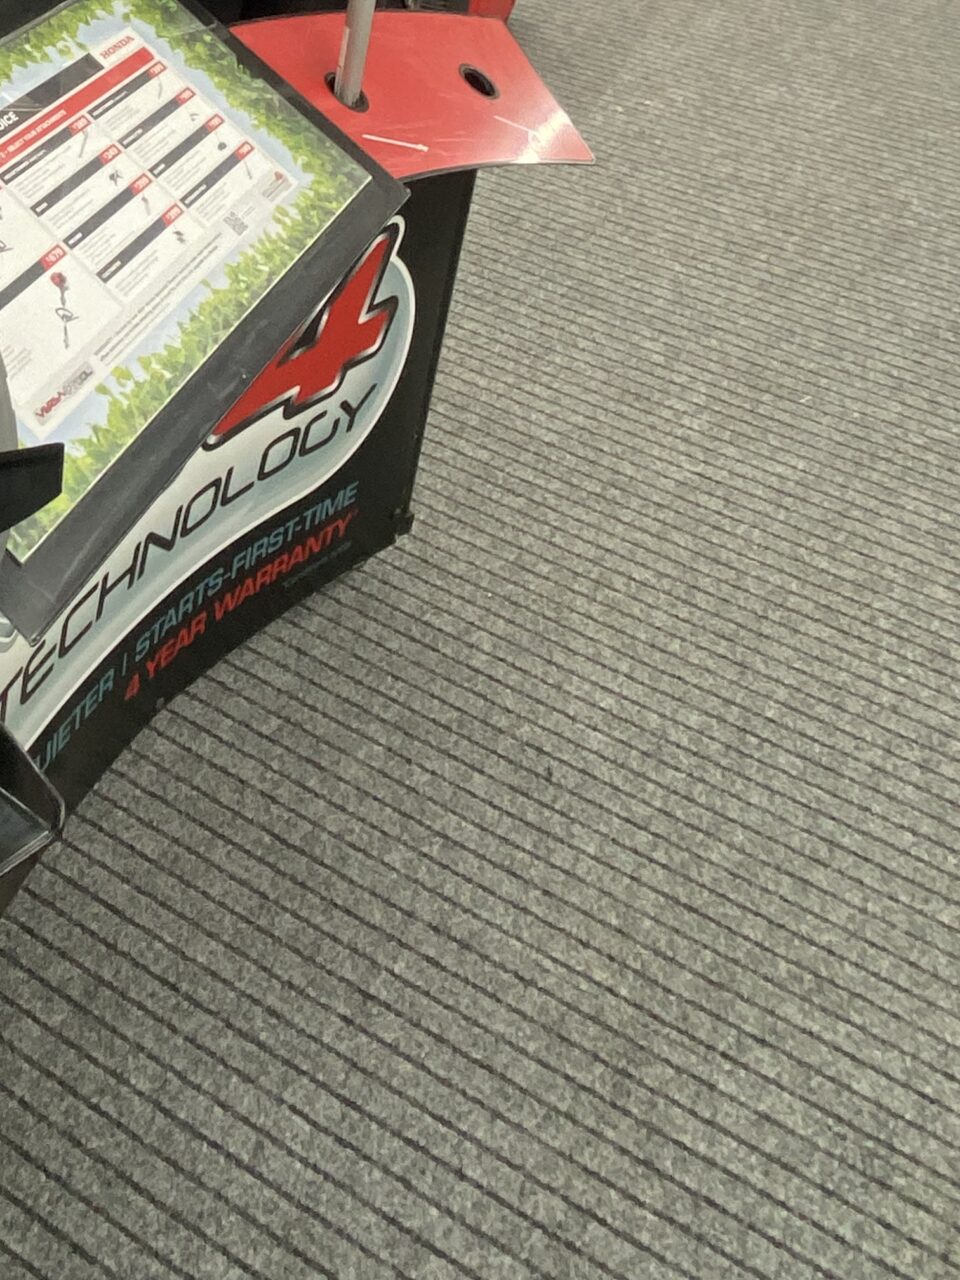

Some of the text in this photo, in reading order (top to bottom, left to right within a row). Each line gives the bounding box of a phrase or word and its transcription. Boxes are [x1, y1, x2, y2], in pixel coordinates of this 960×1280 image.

[99, 35, 135, 60] HONDA
[124, 676, 140, 701] 4
[145, 613, 206, 679] YEAR
[214, 515, 354, 619] WARRANTY
[40, 668, 114, 771] UIETER
